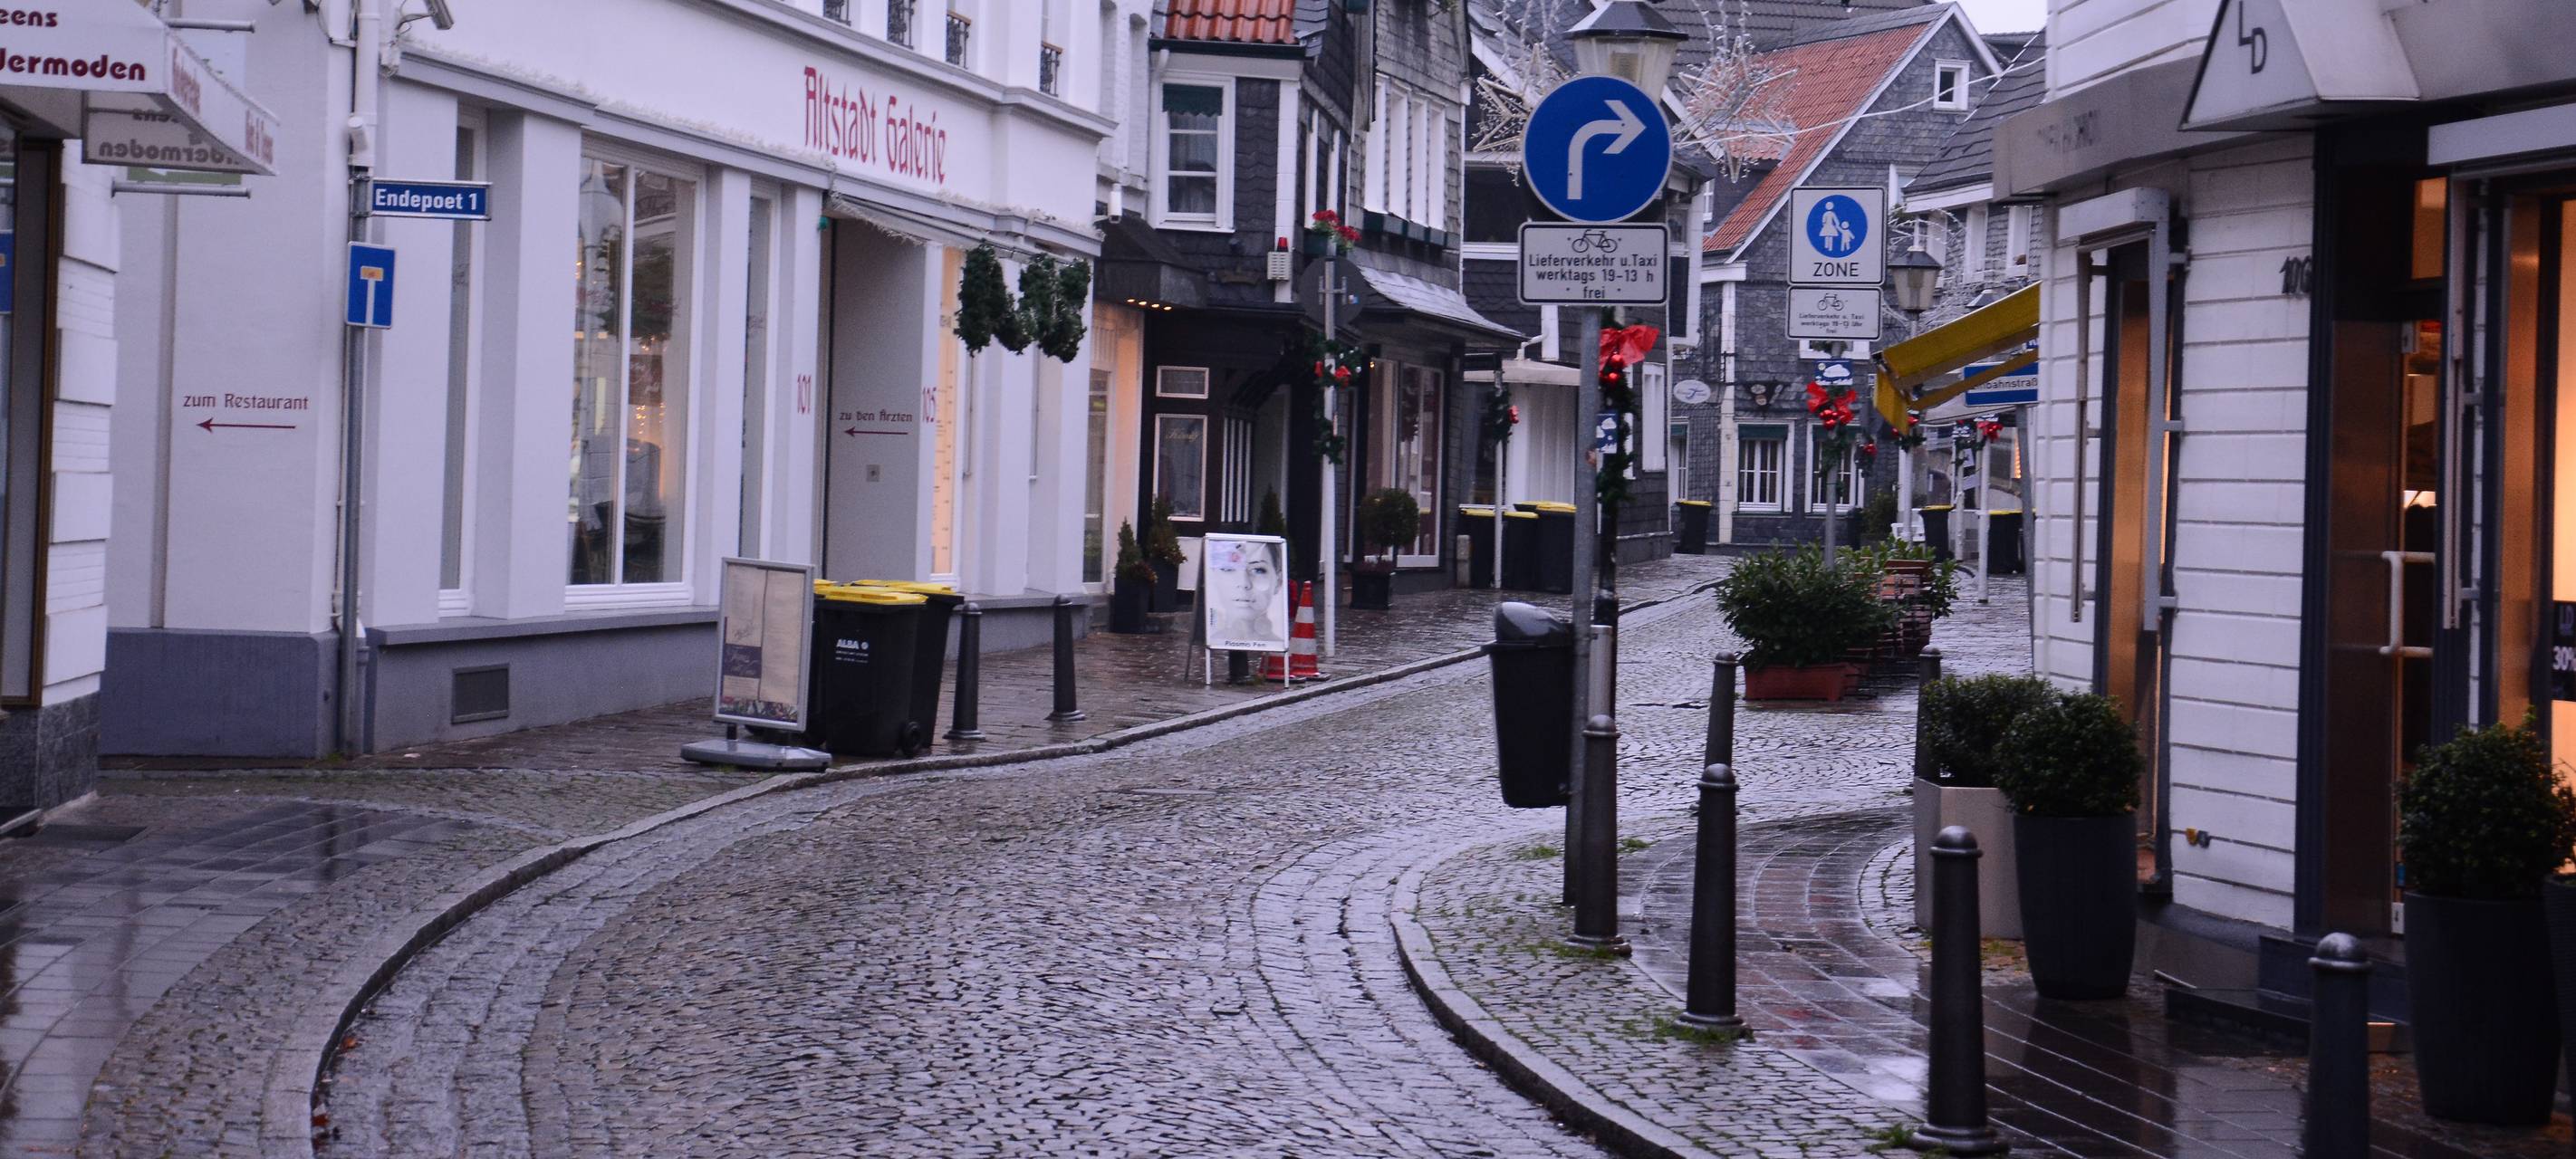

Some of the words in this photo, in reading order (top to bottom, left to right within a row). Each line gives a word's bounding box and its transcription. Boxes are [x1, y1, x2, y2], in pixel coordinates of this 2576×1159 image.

[804, 65, 877, 166] Altstadt
[886, 95, 947, 185] Galerie
[375, 188, 464, 212] Endepoet
[468, 193, 478, 210] 1
[1528, 254, 1615, 268] Lieferverkehr
[1536, 269, 1595, 284] werktags
[1602, 269, 1638, 283] 19-13
[1646, 270, 1654, 283] h
[1812, 262, 1860, 277] ZONE
[1583, 286, 1606, 299] frei
[183, 395, 216, 407] zum
[225, 393, 309, 410] Restaurant
[797, 374, 812, 415] 101
[839, 411, 852, 421] zu
[857, 410, 875, 421] den
